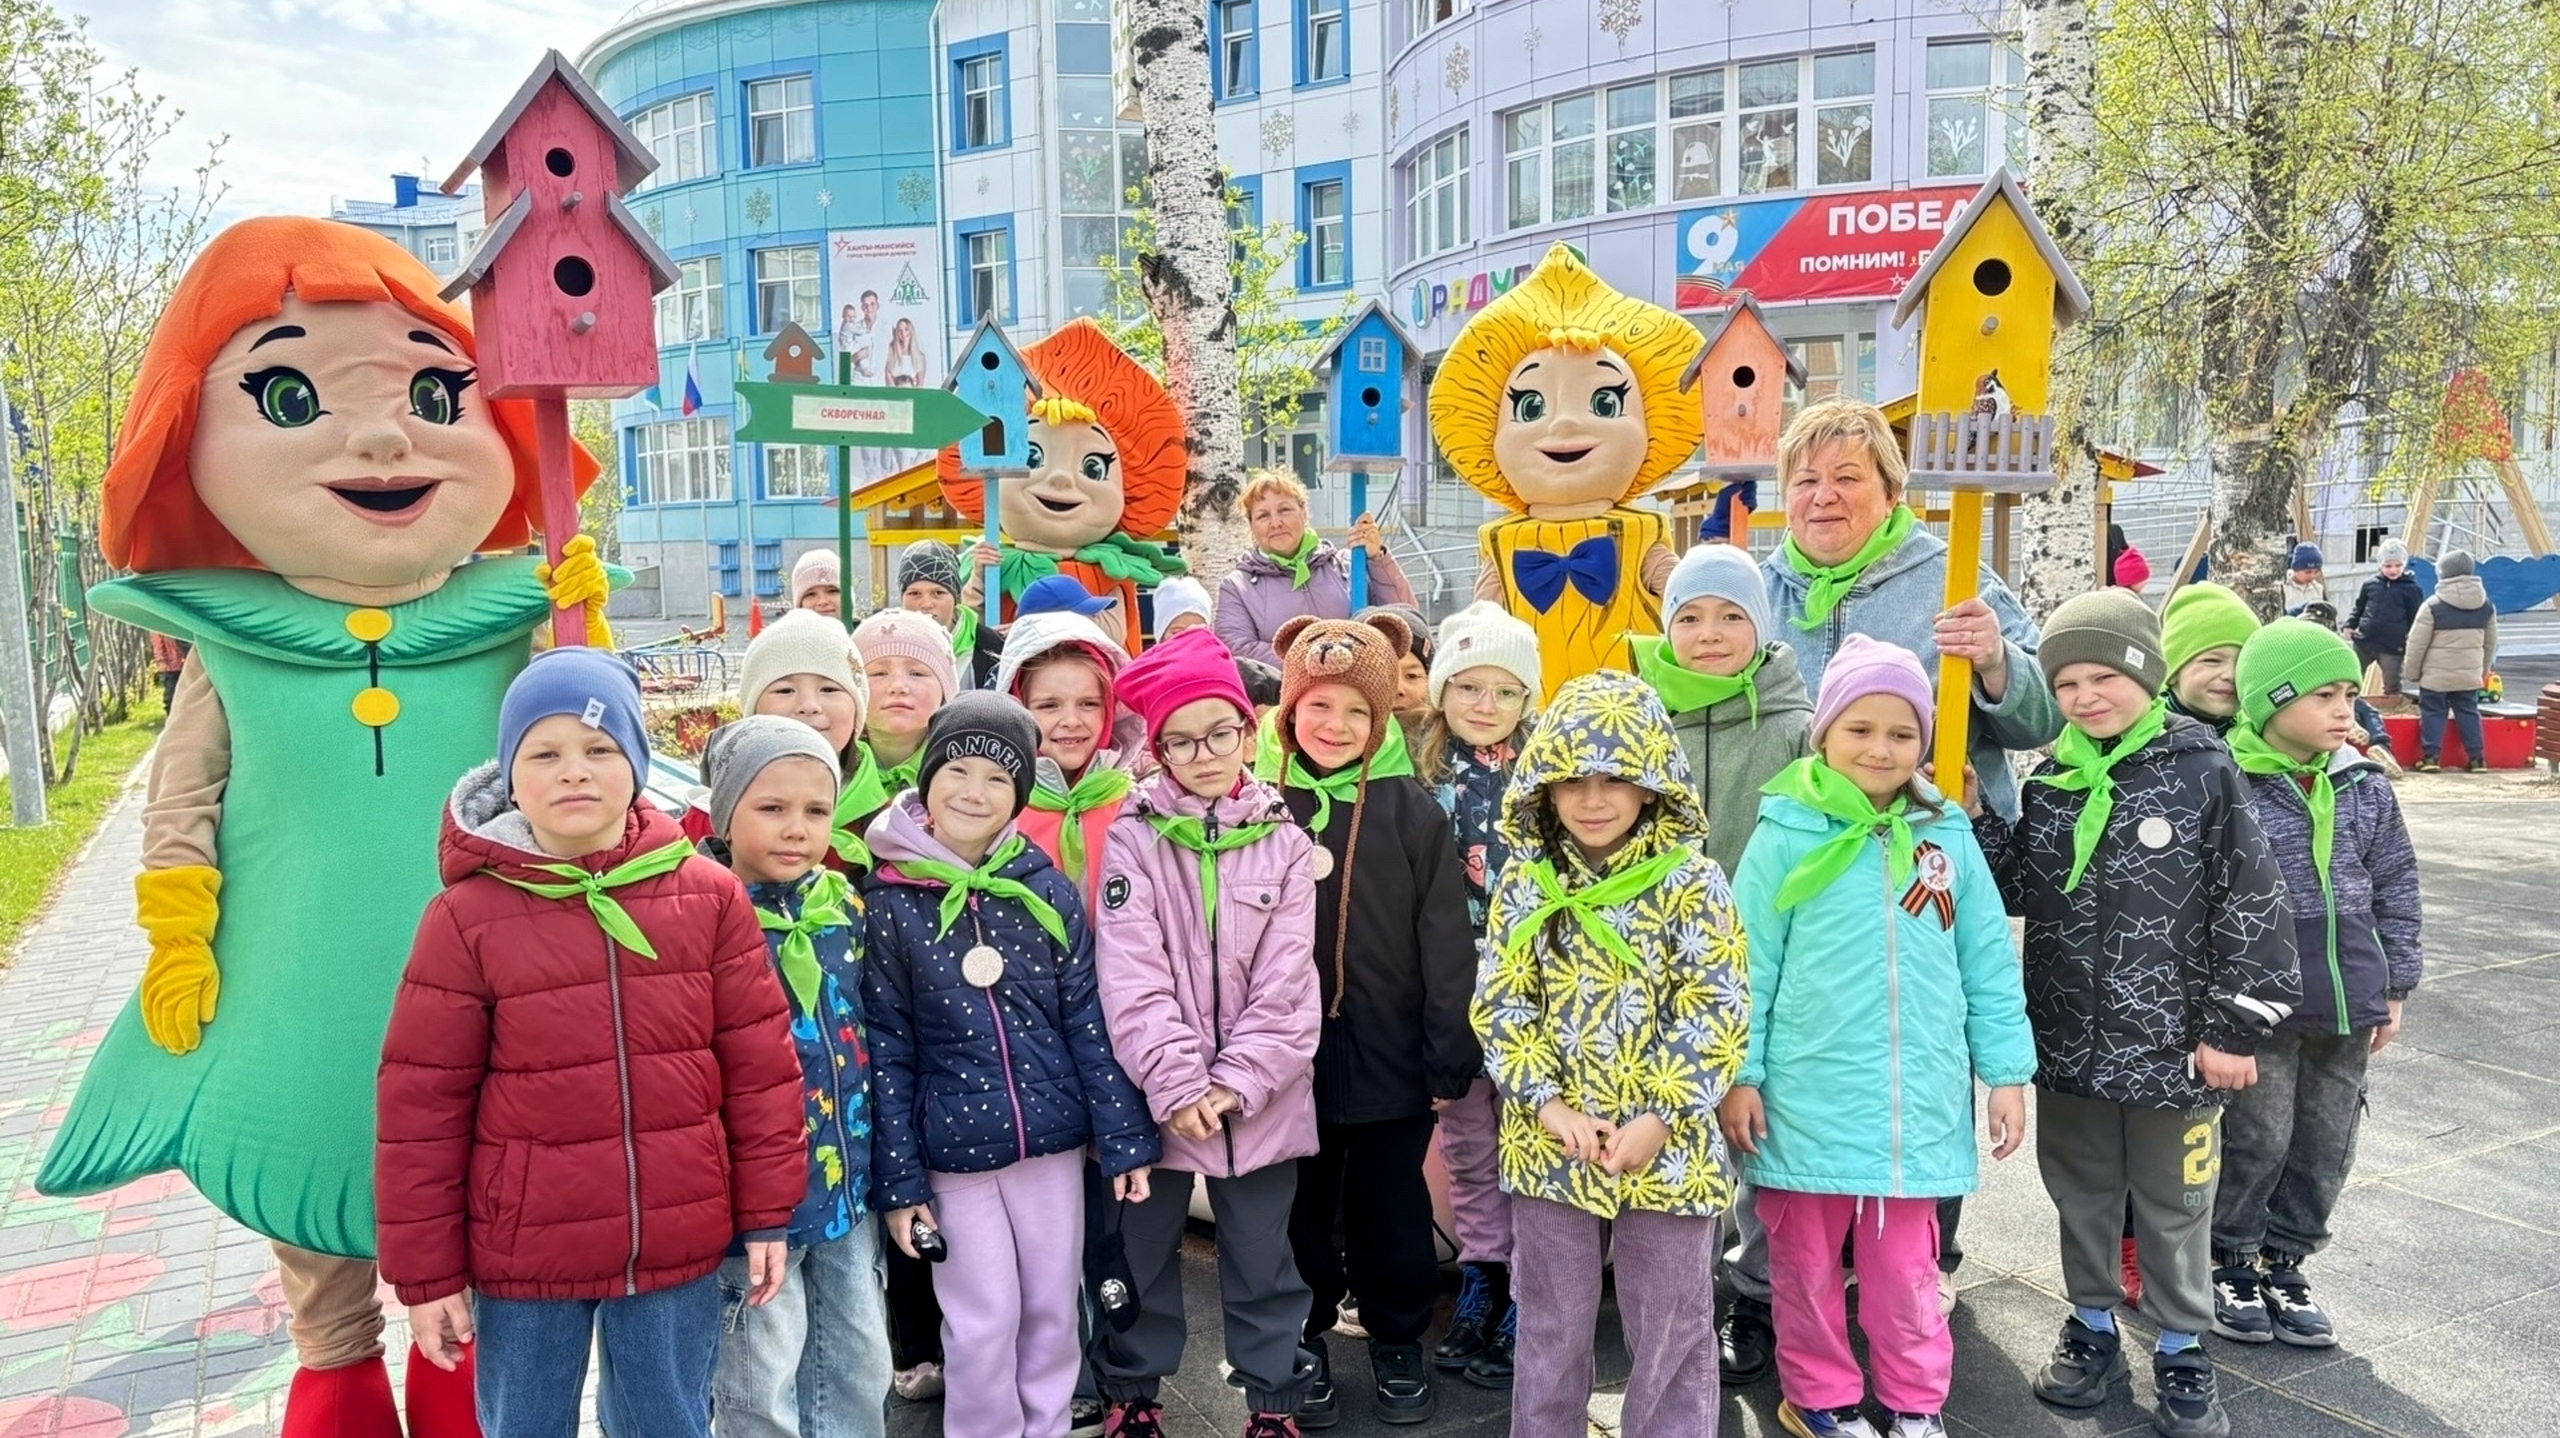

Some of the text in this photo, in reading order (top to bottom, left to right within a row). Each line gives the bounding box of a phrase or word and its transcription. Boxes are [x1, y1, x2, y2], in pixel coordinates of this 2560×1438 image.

[846, 241, 916, 251] ХАНТЫ-МАНСИЙСК
[1687, 213, 1740, 276] 9
[1712, 260, 1745, 273] МАЯ
[1799, 250, 1906, 274] ПОМНИМ!
[820, 407, 886, 421] СКВОРЕЧНАЯ
[946, 735, 1022, 779] ANGEL
[2183, 1190, 2202, 1207] GO
